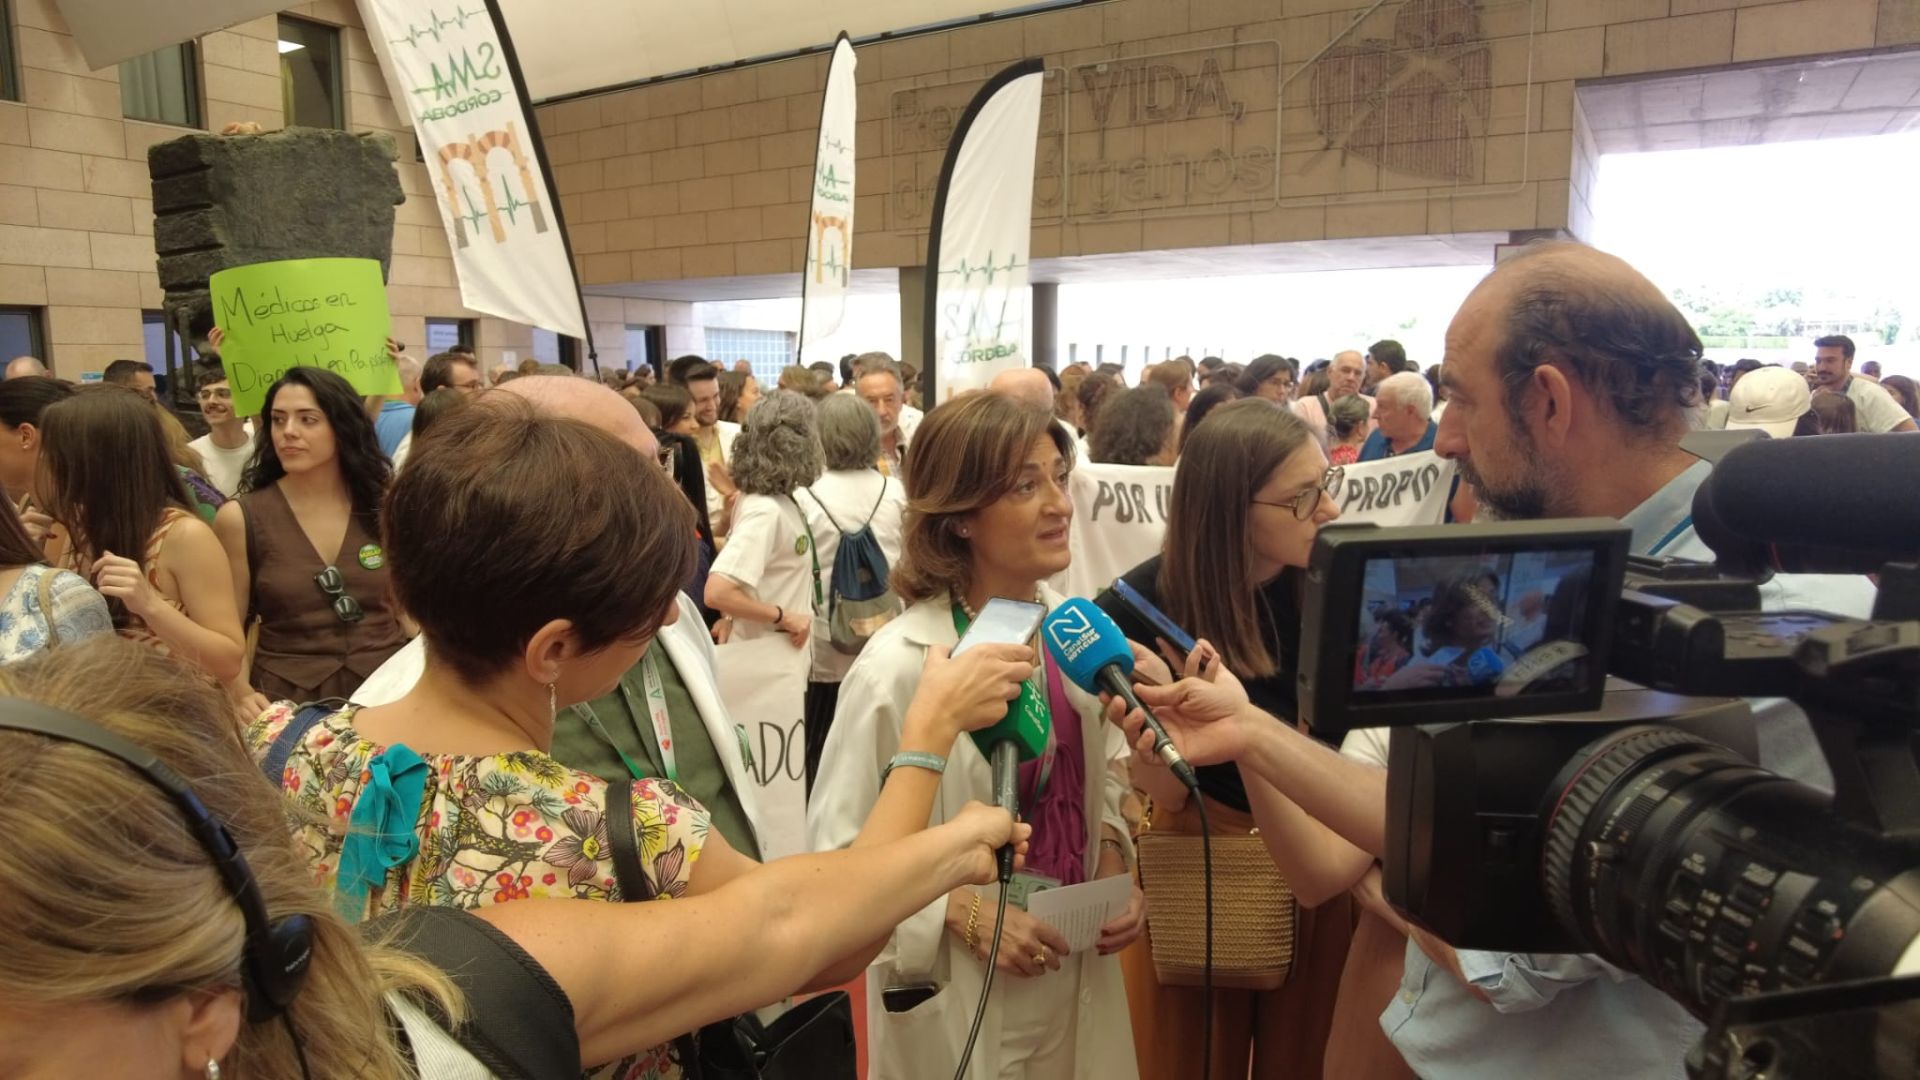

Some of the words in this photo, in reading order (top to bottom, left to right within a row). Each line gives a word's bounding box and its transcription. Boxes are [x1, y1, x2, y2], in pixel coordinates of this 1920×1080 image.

[220, 286, 320, 331] Médicos
[325, 292, 357, 308] en
[270, 320, 349, 351] Huelga
[1091, 480, 1153, 523] POR
